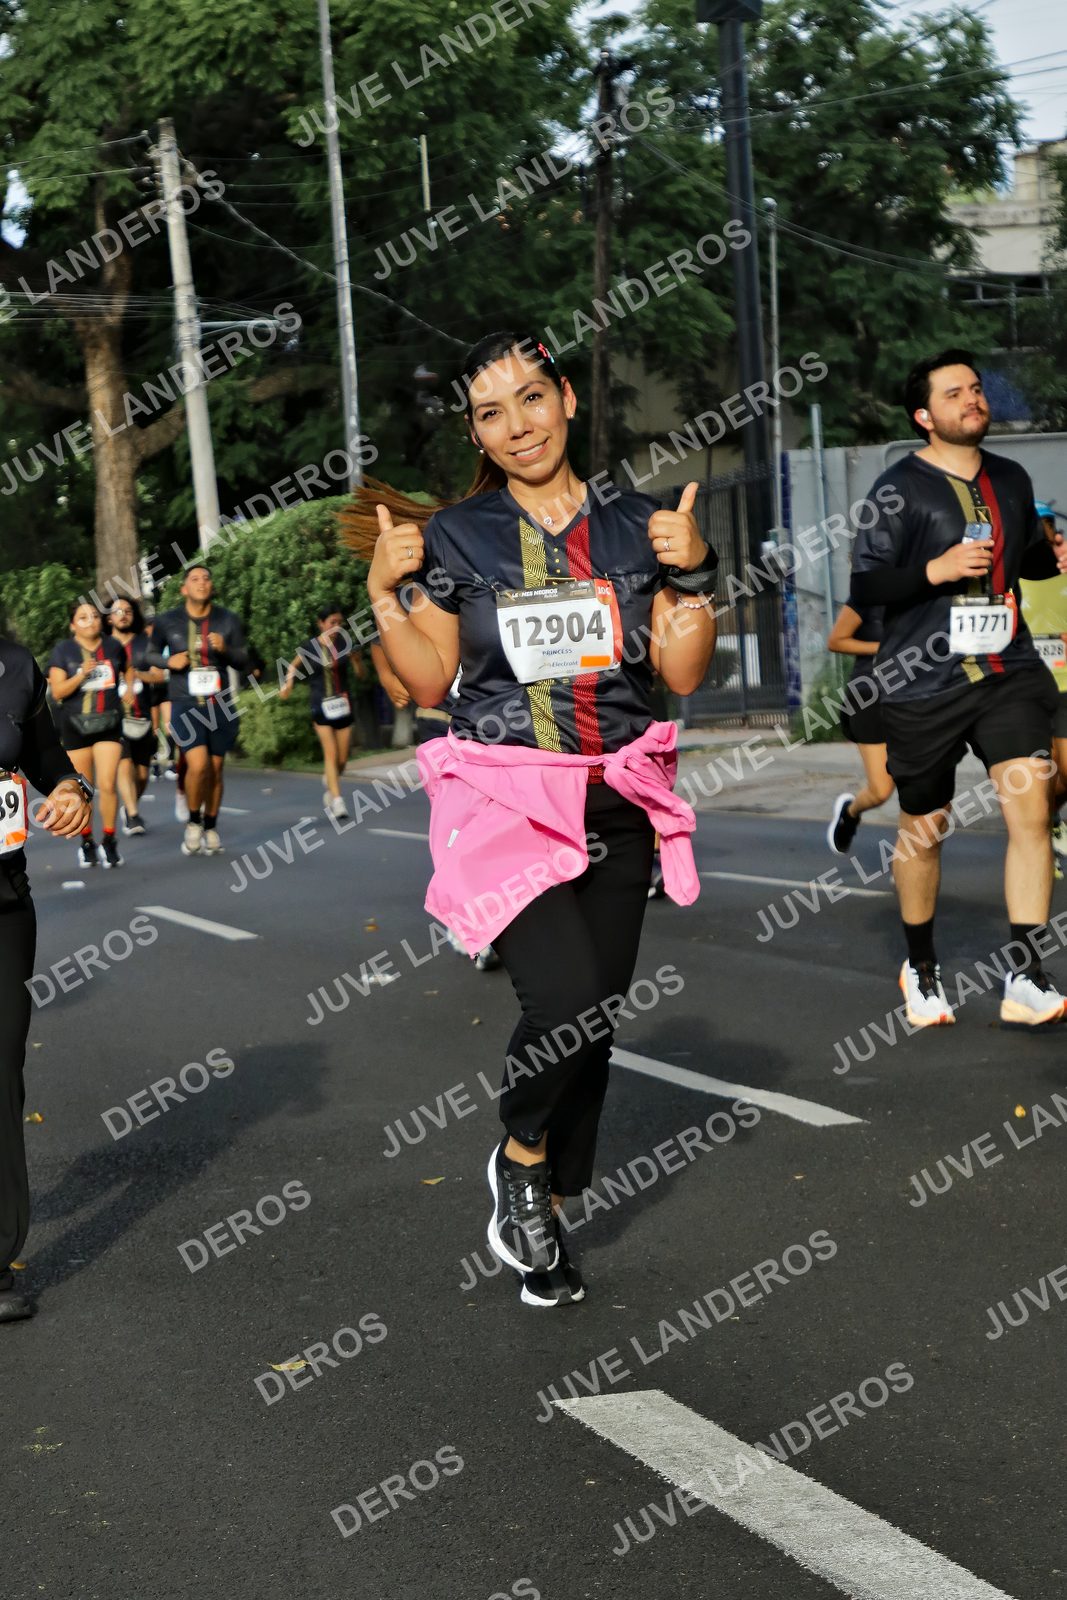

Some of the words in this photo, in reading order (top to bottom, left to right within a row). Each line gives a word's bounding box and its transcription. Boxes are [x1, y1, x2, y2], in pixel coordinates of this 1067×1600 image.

[505, 610, 606, 648] 12904
[955, 613, 1008, 633] 11771
[542, 648, 573, 656] PRINCESS
[0, 790, 19, 821] 9
